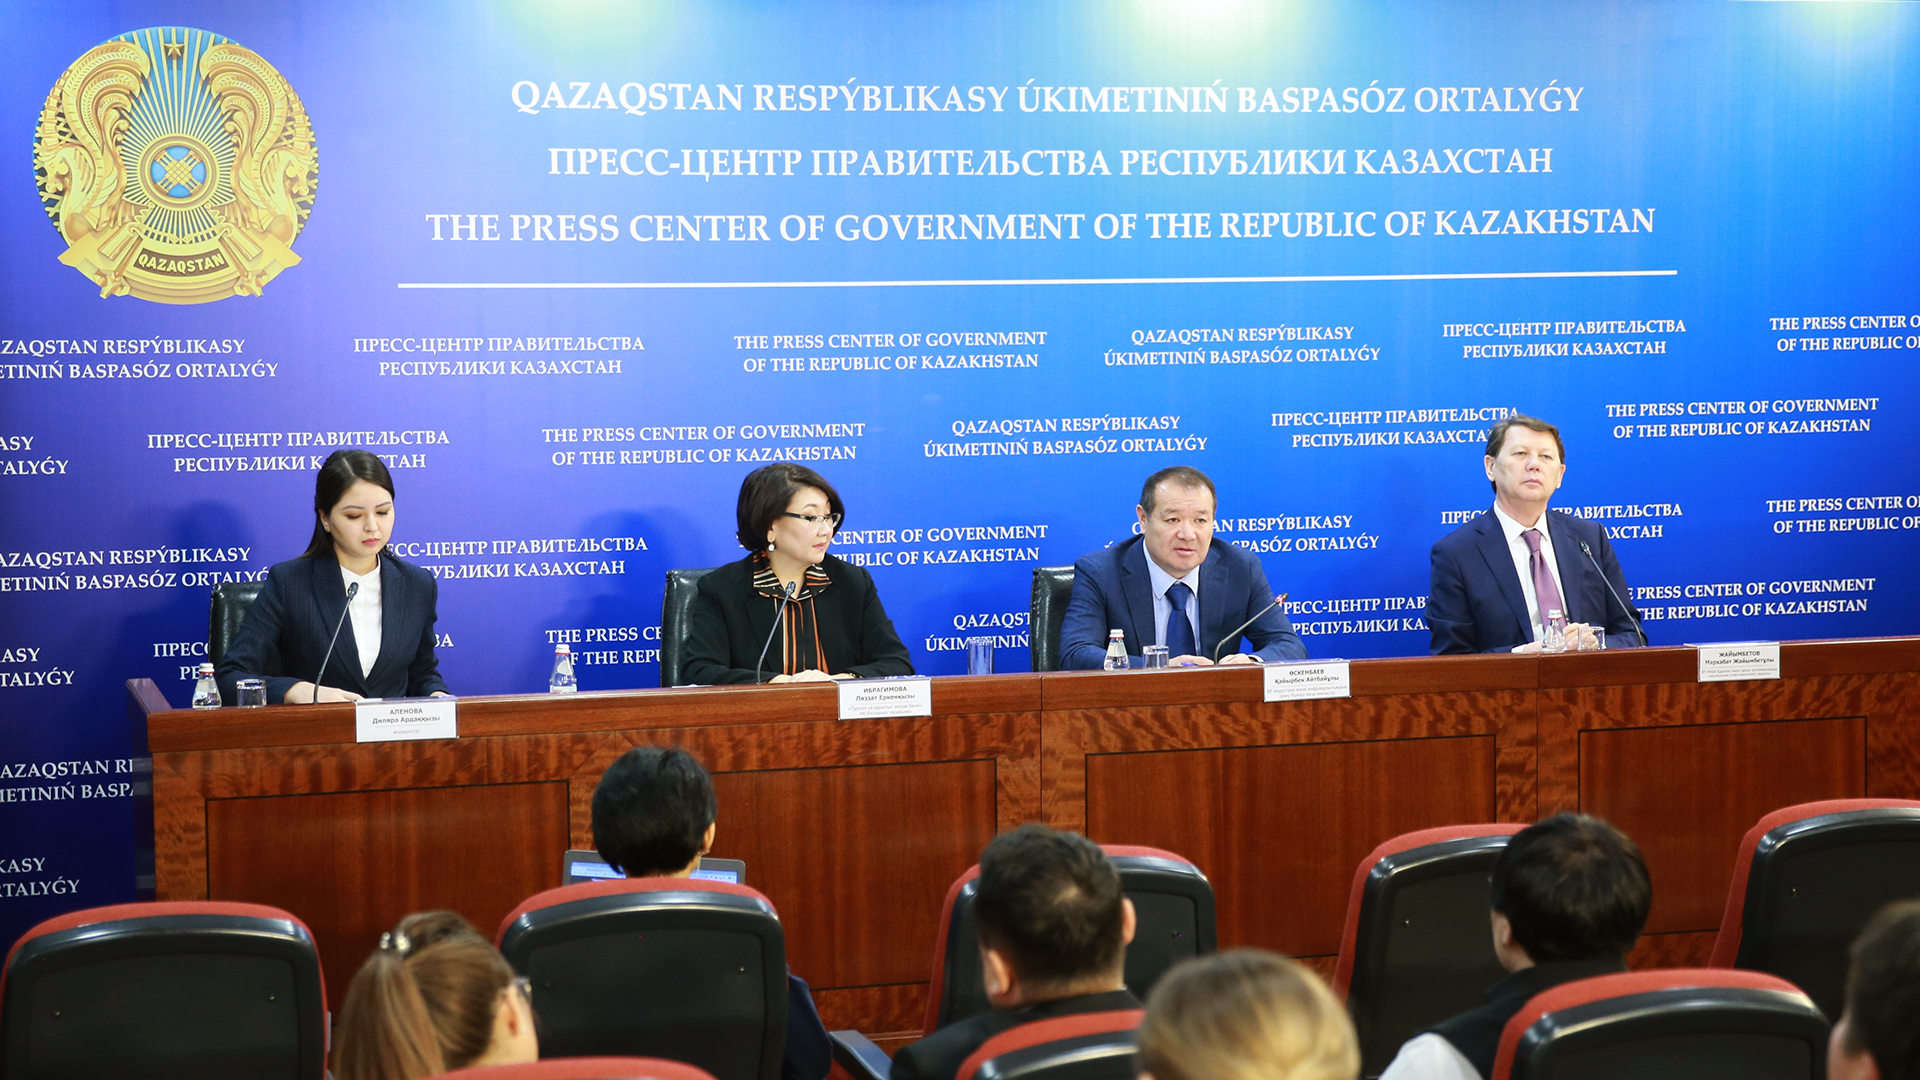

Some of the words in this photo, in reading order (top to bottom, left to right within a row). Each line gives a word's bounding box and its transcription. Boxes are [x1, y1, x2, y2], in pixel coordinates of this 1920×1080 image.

[512, 81, 743, 115] QAZAQSTAN
[753, 78, 1008, 112] RESPÝBLIKASY
[1017, 79, 1228, 112] ÚKIMETINIŃ
[1238, 80, 1405, 113] BASPASÓZ
[549, 149, 802, 182] ПРЕСС-ЦЕНТР
[810, 149, 1112, 177] ПРАВИТЕЛЬСТВА
[1119, 149, 1347, 176] РЕСПУБЛИКИ
[1354, 147, 1554, 175] КАЗАХСТАН
[425, 214, 501, 241] THE
[510, 214, 619, 242] PRESS
[629, 214, 771, 242] CENTER
[779, 214, 825, 242] OF
[834, 213, 1086, 242] GOVERNMENT
[1093, 212, 1138, 240] OF
[1145, 212, 1212, 239] THE
[1219, 210, 1377, 239] REPUBLIC
[1384, 210, 1427, 237] OF
[1433, 207, 1656, 236] KAZAKHSTAN
[138, 253, 225, 274] QAZAQSTAN
[1442, 321, 1552, 339] ПРЕСС-ЦЕНТР
[1553, 319, 1687, 336] ПРАВИТЕЛЬСТВА
[1768, 316, 1800, 331] THE
[1801, 315, 1847, 331] PRESS
[1848, 314, 1908, 330] CENTER
[733, 335, 769, 350] THE
[772, 334, 825, 349] PRESS
[827, 333, 896, 349] CENTER
[898, 332, 922, 348] OF
[925, 331, 1048, 347] GOVERNMENT
[1130, 328, 1235, 347] QAZAQSTAN
[1237, 323, 1355, 343] RESPÝBLIKASY
[1776, 337, 1798, 352] OF
[1798, 337, 1830, 352] THE
[1831, 335, 1904, 351] REPUBLIC
[0, 339, 98, 358] ZAQSTAN
[102, 335, 246, 355] RESPÝBLIKASY
[353, 337, 484, 355] ПРЕСС-ЦЕНТР
[488, 336, 646, 352] ПРАВИТЕЛЬСТВА
[1209, 345, 1294, 365] BASPASÓZ
[1462, 342, 1570, 359] РЕСПУБЛИКИ
[1571, 338, 1667, 357] КАЗАХСТАН
[68, 359, 172, 379] BASPASÓZ
[379, 361, 506, 376] РЕСПУБЛИКИ
[510, 359, 622, 375] КАЗАХСТАН
[743, 358, 767, 373] OF
[769, 357, 806, 372] THE
[808, 355, 892, 372] REPUBLIC
[894, 355, 918, 370] OF
[921, 353, 1039, 370] KAZAKHSTAN
[1604, 403, 1637, 418] THE
[1638, 402, 1685, 417] PRESS
[1686, 400, 1747, 416] CENTER
[1748, 400, 1770, 415] OF
[1771, 397, 1880, 414] GOVERNMENT
[951, 418, 1058, 438] QAZAQSTAN
[1060, 413, 1181, 433] RESPÝBLIKASY
[1270, 410, 1383, 428] ПРЕСС-ЦЕНТР
[1612, 424, 1635, 439] OF
[1635, 423, 1668, 438] THE
[1669, 421, 1743, 437] REPUBLIC
[1744, 421, 1766, 436] OF
[1767, 418, 1872, 435] KAZAKHSTAN
[147, 432, 283, 451] ПРЕСС-ЦЕНТР
[286, 430, 450, 447] ПРАВИТЕЛЬСТВА
[541, 428, 579, 443] THE
[582, 427, 636, 442] PRESS
[639, 426, 710, 442] CENTER
[712, 425, 736, 440] OF
[739, 422, 866, 440] GOVERNMENT
[1291, 431, 1401, 448] РЕСПУБЛИКИ
[1402, 428, 1492, 445] КАЗАХСТА
[551, 451, 576, 466] OF
[579, 450, 616, 465] THE
[619, 448, 705, 465] REPUBLIC
[708, 448, 732, 463] OF
[735, 445, 857, 462] KAZAKHSTAN
[923, 437, 1029, 458] ÚKIMETINIŃ
[1031, 435, 1118, 455] BASPASÓZ
[173, 455, 306, 473] РЕСПУБЛИКИ
[1765, 499, 1797, 514] THE
[1798, 497, 1844, 513] PRESS
[1845, 495, 1904, 511] CENTER
[1236, 513, 1354, 532] RESPÝBLIKASY
[1772, 519, 1794, 534] OF
[1795, 518, 1827, 533] THE
[1828, 516, 1900, 532] REPUBLIC
[830, 528, 898, 546] CENTER
[900, 528, 924, 544] OF
[926, 524, 1049, 543] GOVERNMENT
[108, 545, 251, 565] RESPÝBLIKASY
[387, 540, 488, 560] ЕСС-ЦЕНТР
[491, 536, 649, 555] ПРАВИТЕЛЬСТВА
[896, 550, 920, 566] OF
[922, 546, 1040, 565] KAZAKHSTAN
[513, 560, 626, 578] КАЗАХСТАН
[0, 571, 71, 592] ETINIŃ
[74, 568, 178, 590] BASPASÓZ
[1636, 585, 1682, 600] PRESS
[1684, 582, 1744, 599] CENTER
[1745, 581, 1767, 596] OF
[1768, 577, 1877, 595] GOVERNMENT
[1383, 595, 1429, 611] ПРАВ
[1666, 603, 1740, 620] REPUBLIC
[1741, 602, 1763, 617] OF
[1764, 598, 1868, 616] KAZAKHSTAN
[544, 628, 582, 644] THE
[585, 626, 639, 643] PRESS
[1291, 618, 1399, 636] РЕСПУБЛИКИ
[0, 647, 41, 664] ASY
[582, 650, 619, 666] THE
[372, 717, 398, 725] Диляра
[80, 782, 134, 799] BASP
